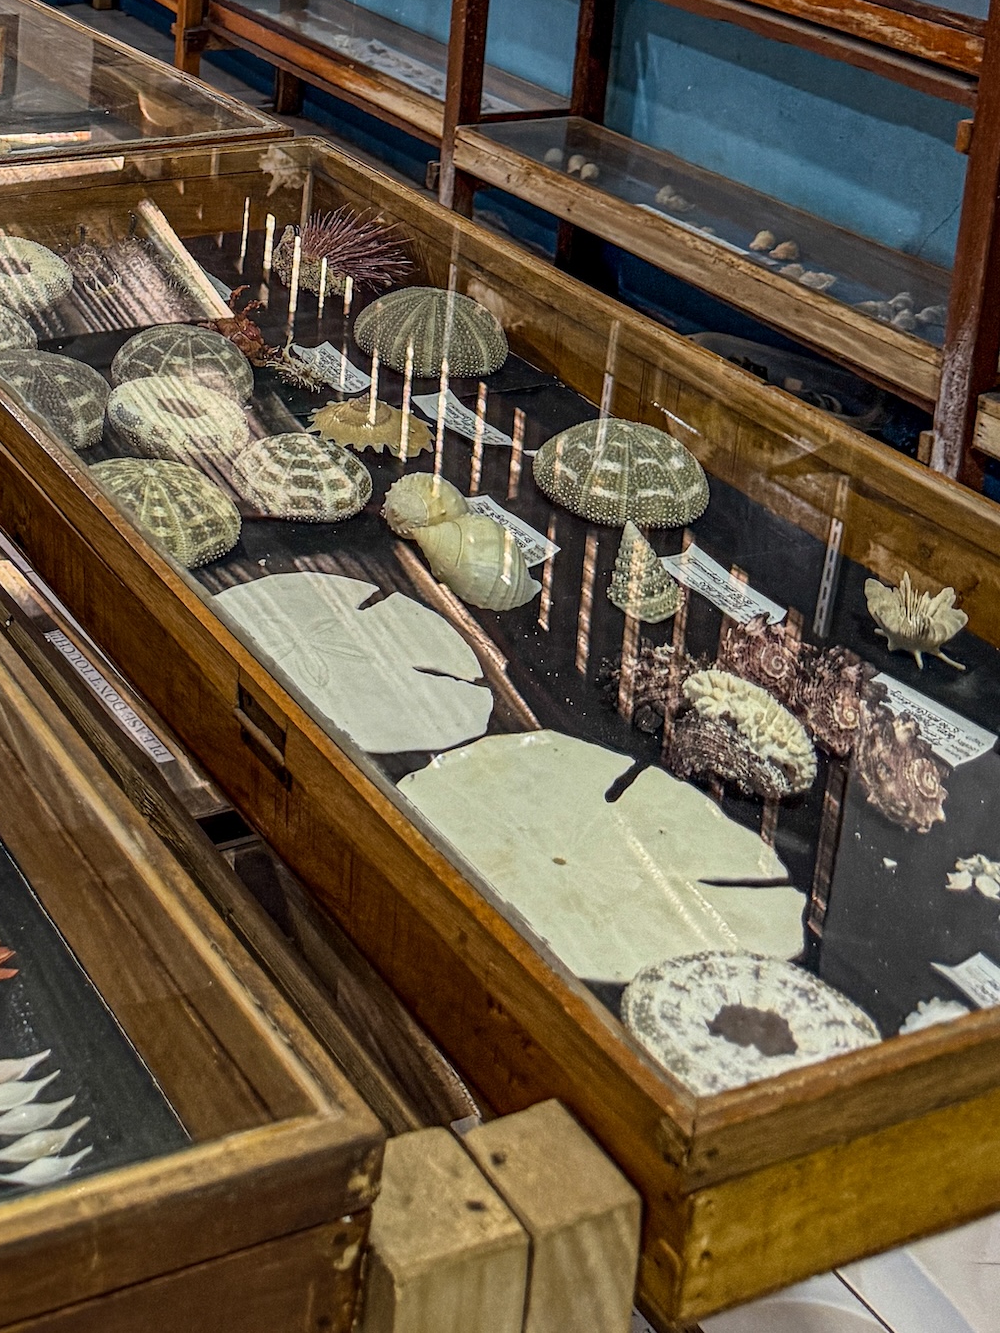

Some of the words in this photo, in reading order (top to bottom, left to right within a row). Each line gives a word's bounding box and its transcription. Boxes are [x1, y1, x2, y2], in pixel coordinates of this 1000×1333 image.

[48, 631, 96, 674] TOUCH!!!
[87, 674, 129, 711] DON'T
[119, 711, 170, 757] PLEASE
